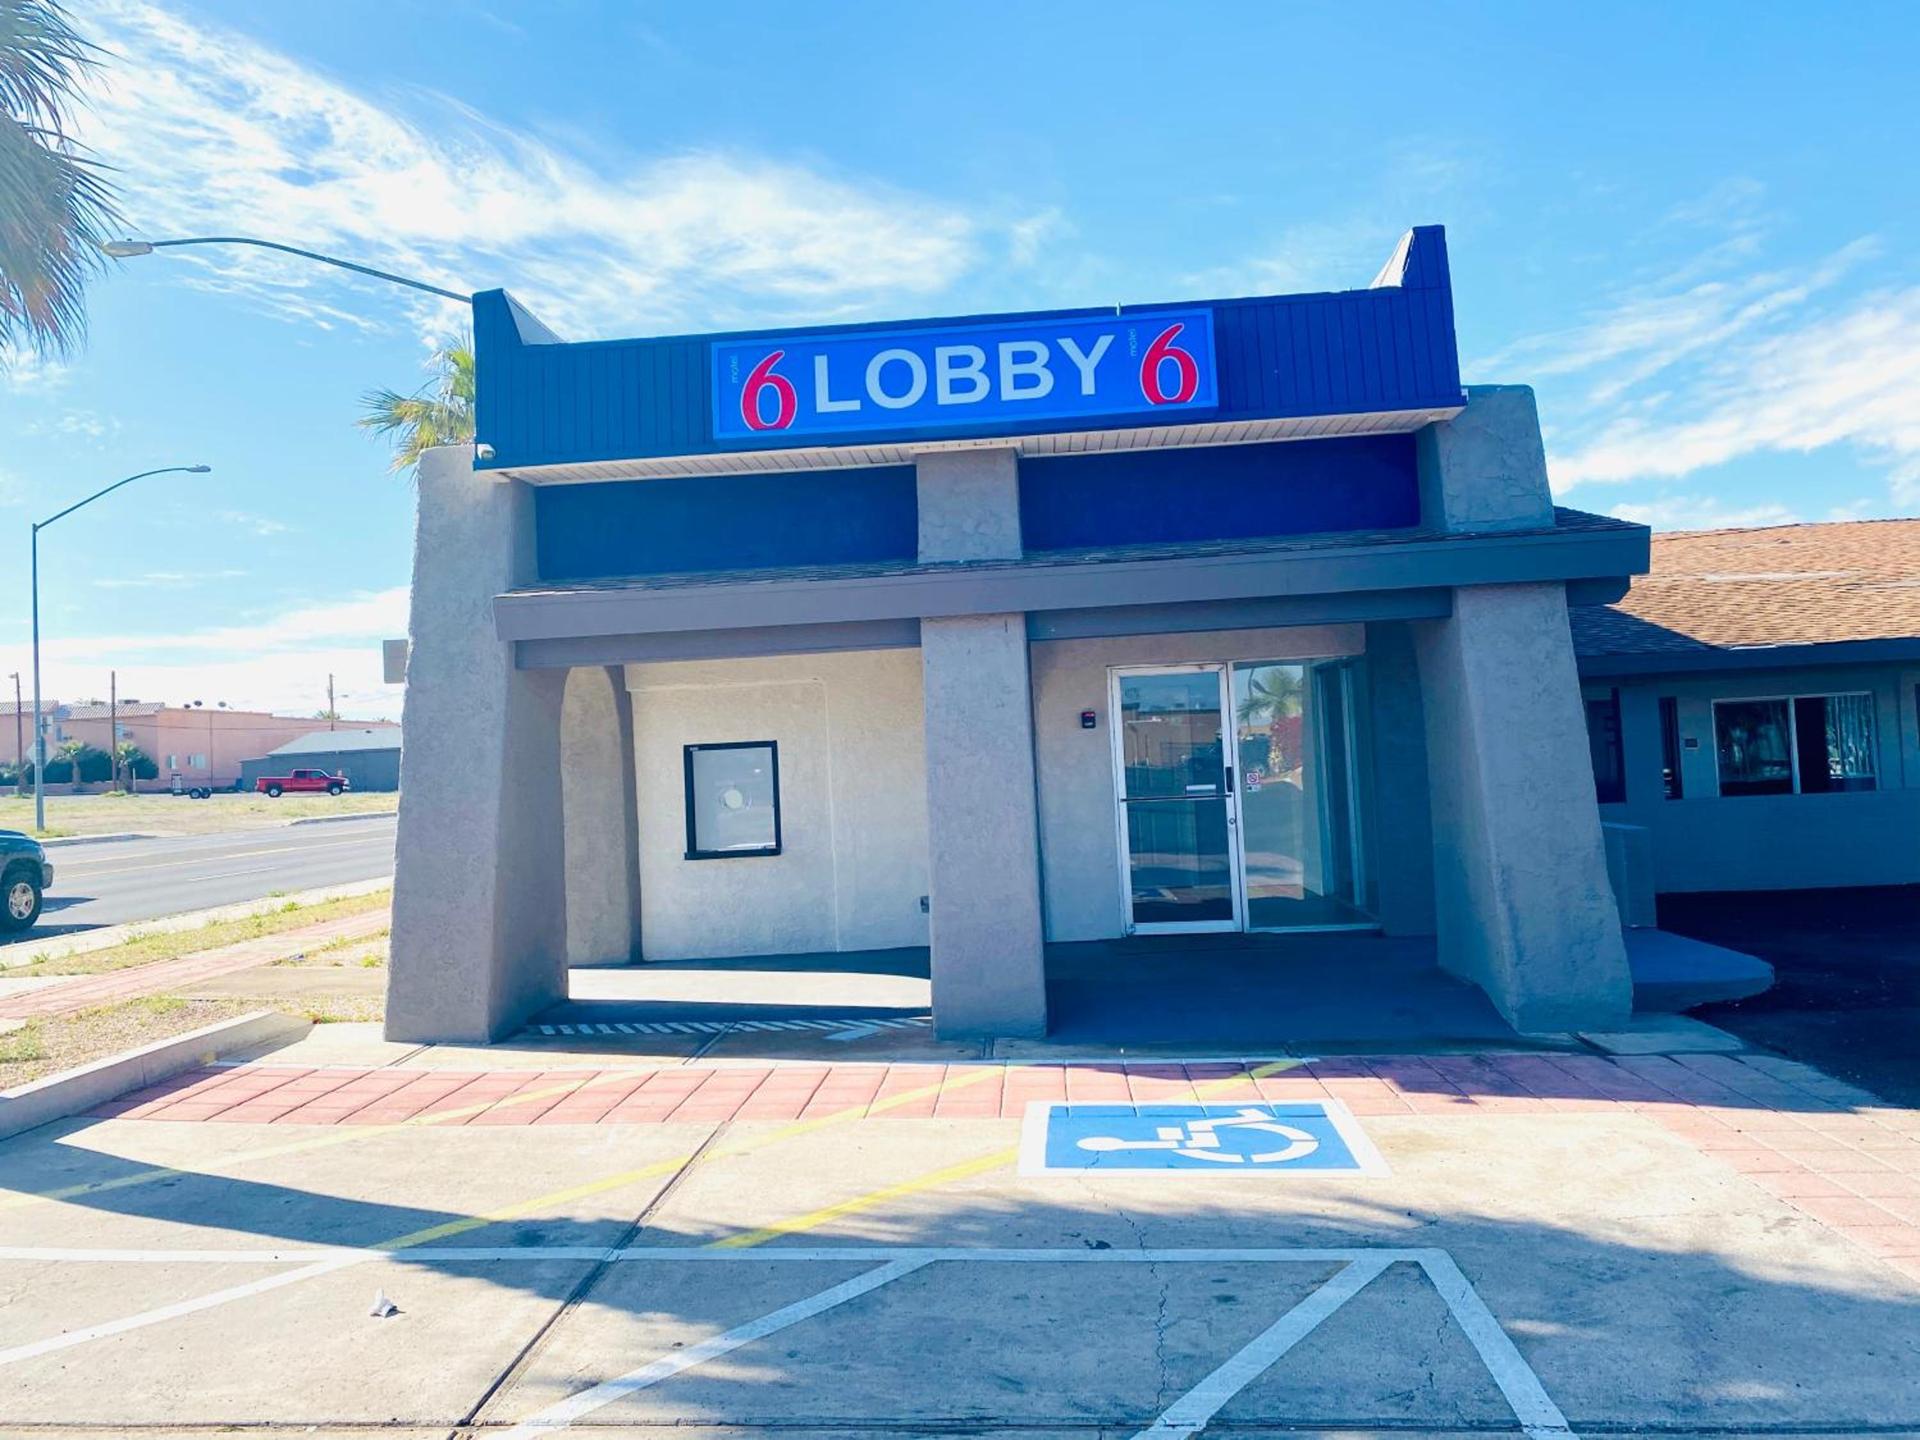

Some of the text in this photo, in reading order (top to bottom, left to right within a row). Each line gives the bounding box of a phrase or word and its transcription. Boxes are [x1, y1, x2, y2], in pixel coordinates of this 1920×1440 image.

[740, 350, 798, 431] 6
[814, 335, 1114, 412] LOBBY
[1140, 323, 1199, 405] 6
